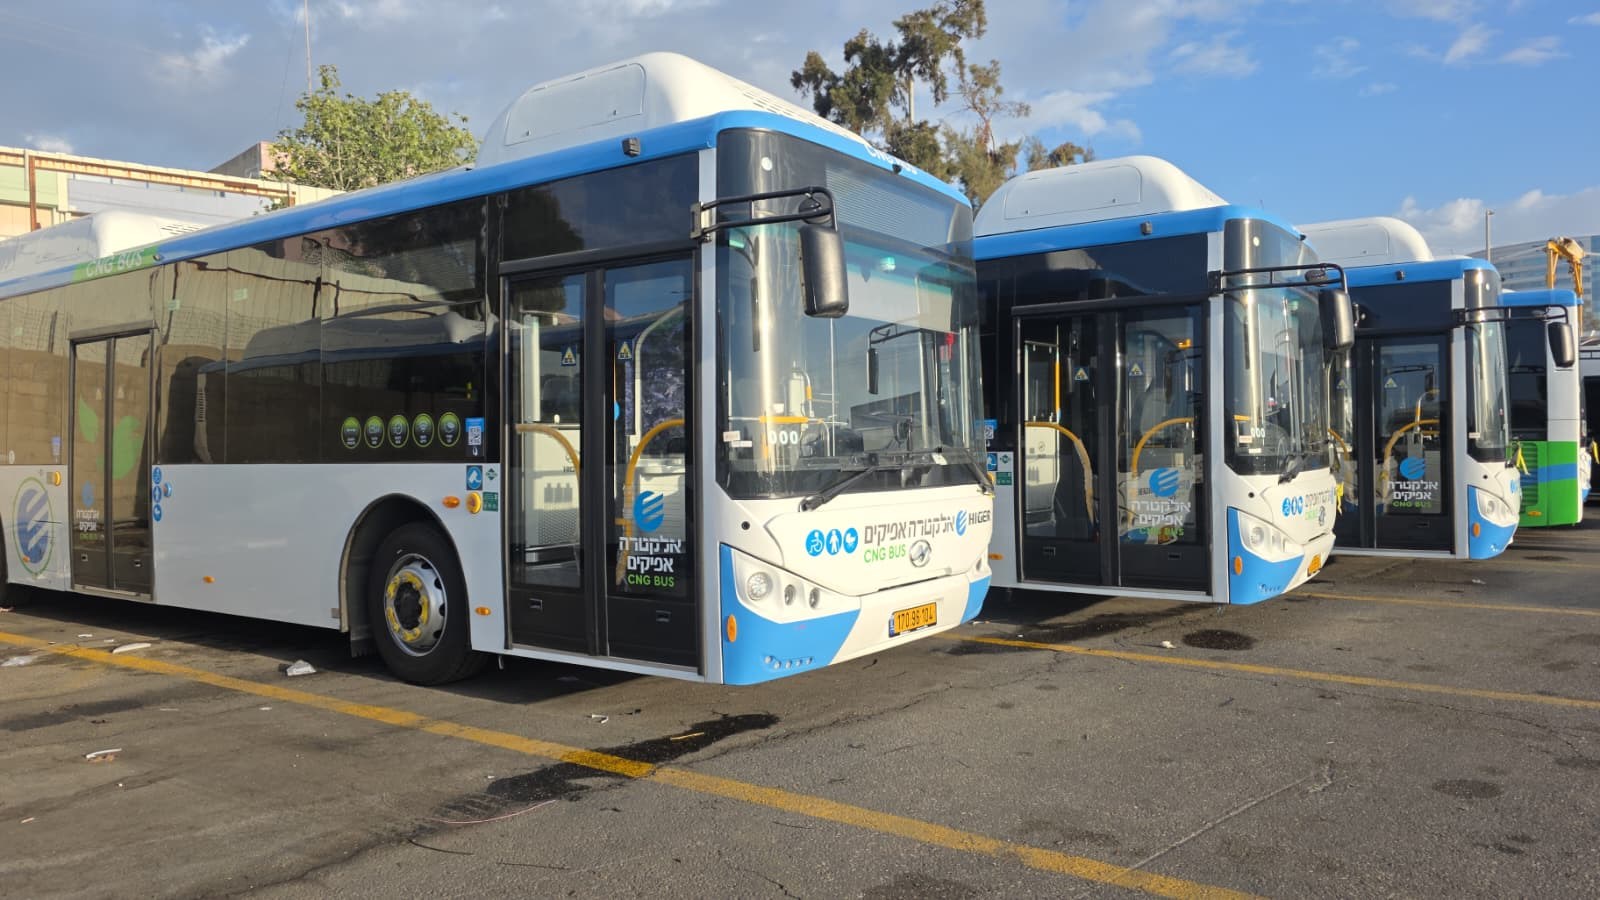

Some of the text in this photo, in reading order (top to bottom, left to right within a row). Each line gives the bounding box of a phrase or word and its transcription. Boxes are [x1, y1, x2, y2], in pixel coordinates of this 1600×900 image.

[87, 251, 142, 276] CNG BUS
[1387, 480, 1438, 491] אלקטרה
[1393, 491, 1431, 501] אפיקים
[1131, 498, 1191, 514] אלקטרה
[968, 510, 991, 525] HIGER
[1139, 514, 1183, 526] אפיקים
[864, 513, 955, 546] אלקטרה אפיקים
[619, 535, 682, 555] אלקטרה
[864, 544, 906, 563] CNG BUS
[627, 555, 674, 574] אפיקים
[628, 574, 674, 587] CNG BUS
